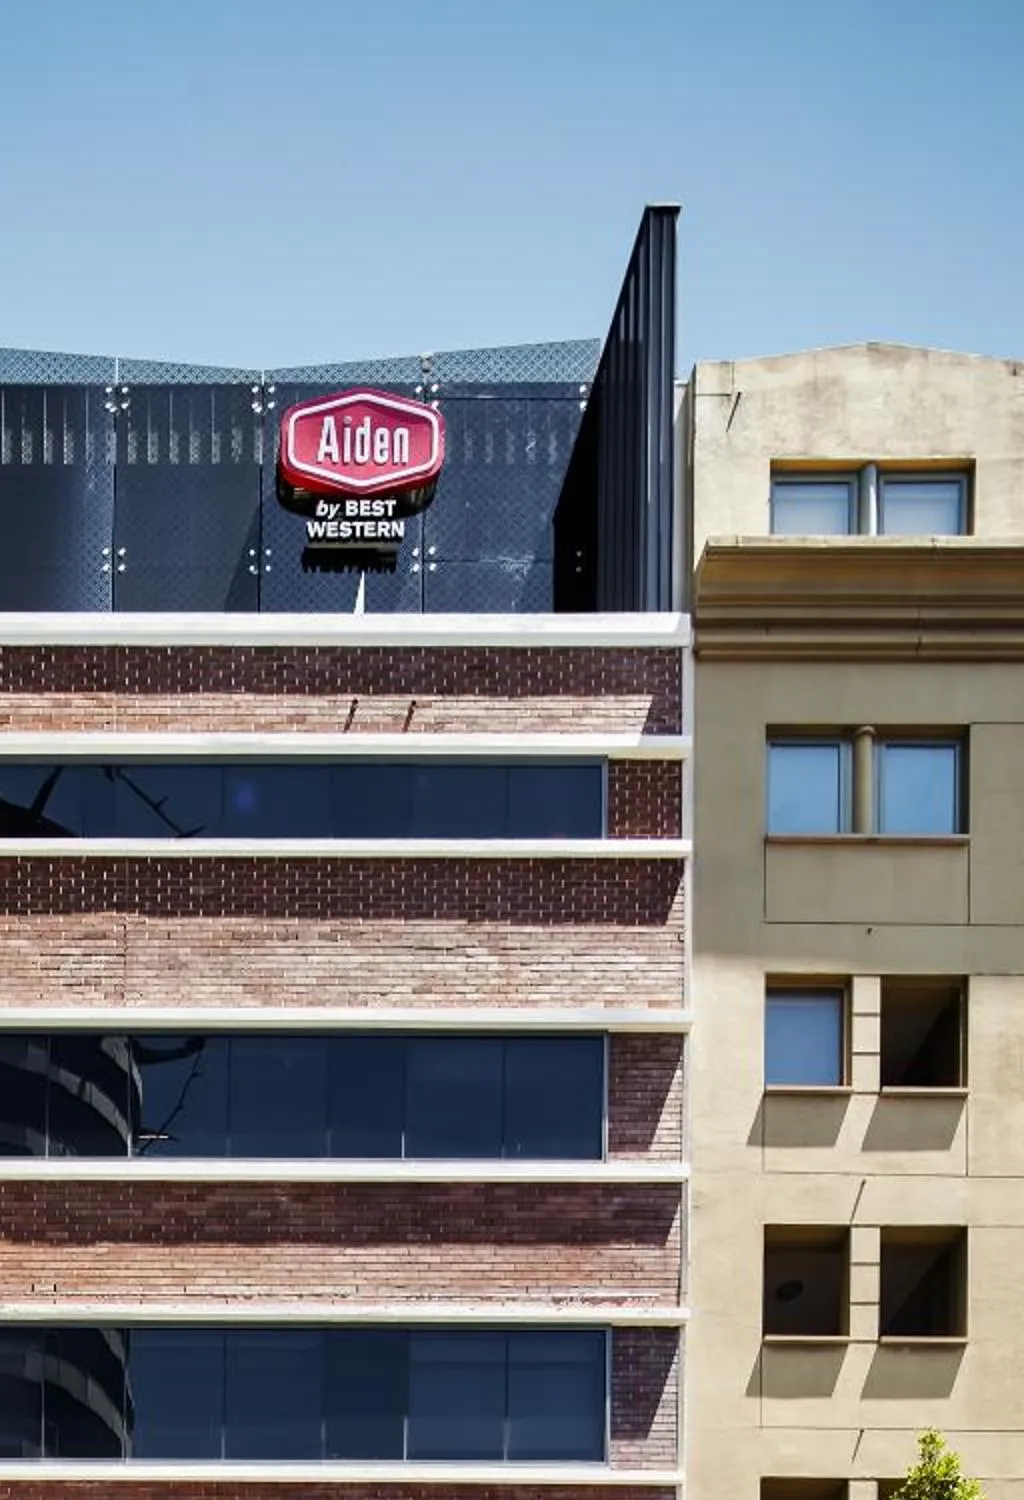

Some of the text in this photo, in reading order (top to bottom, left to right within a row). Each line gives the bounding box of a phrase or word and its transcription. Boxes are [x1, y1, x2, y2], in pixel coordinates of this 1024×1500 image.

[316, 415, 410, 465] Aiden
[315, 499, 397, 519] by BEST
[306, 520, 405, 538] WESTERN
